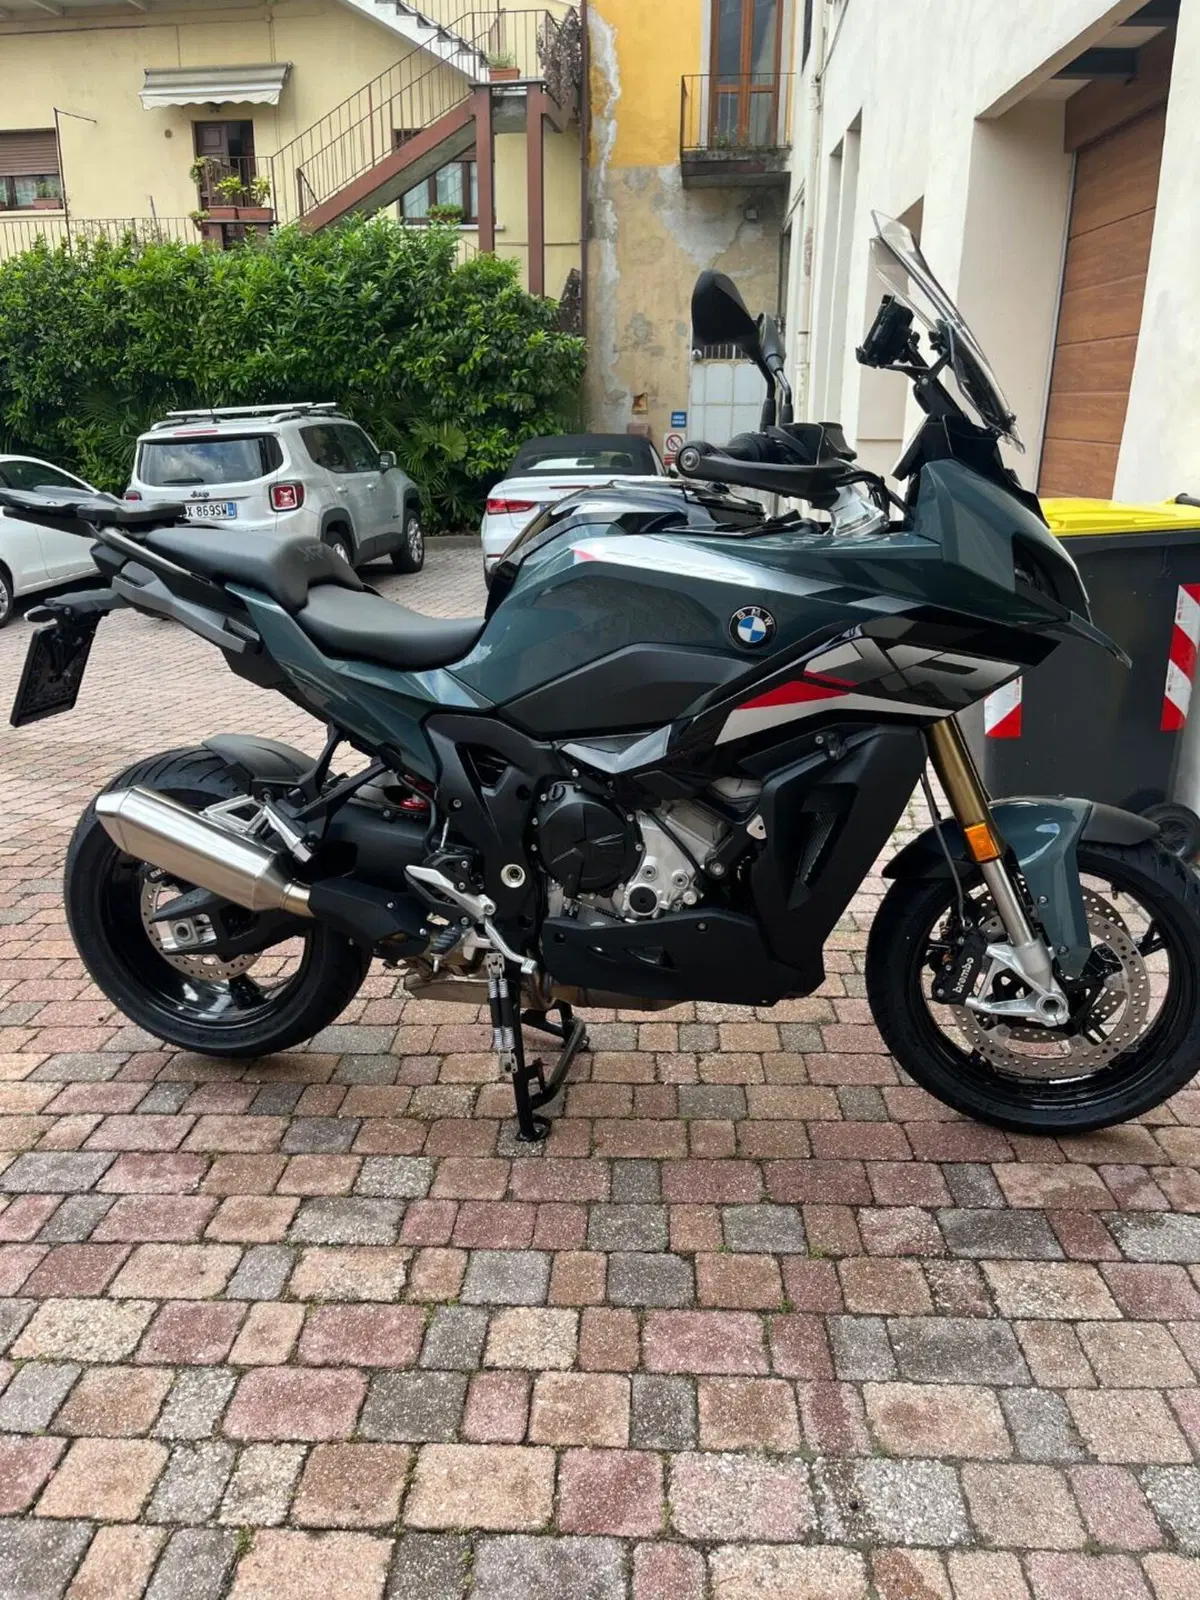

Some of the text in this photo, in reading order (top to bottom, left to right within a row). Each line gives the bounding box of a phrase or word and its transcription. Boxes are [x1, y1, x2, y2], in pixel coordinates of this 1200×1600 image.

[196, 504, 227, 517] 869SW
[736, 608, 773, 626] BMW
[951, 956, 974, 994] brembo
